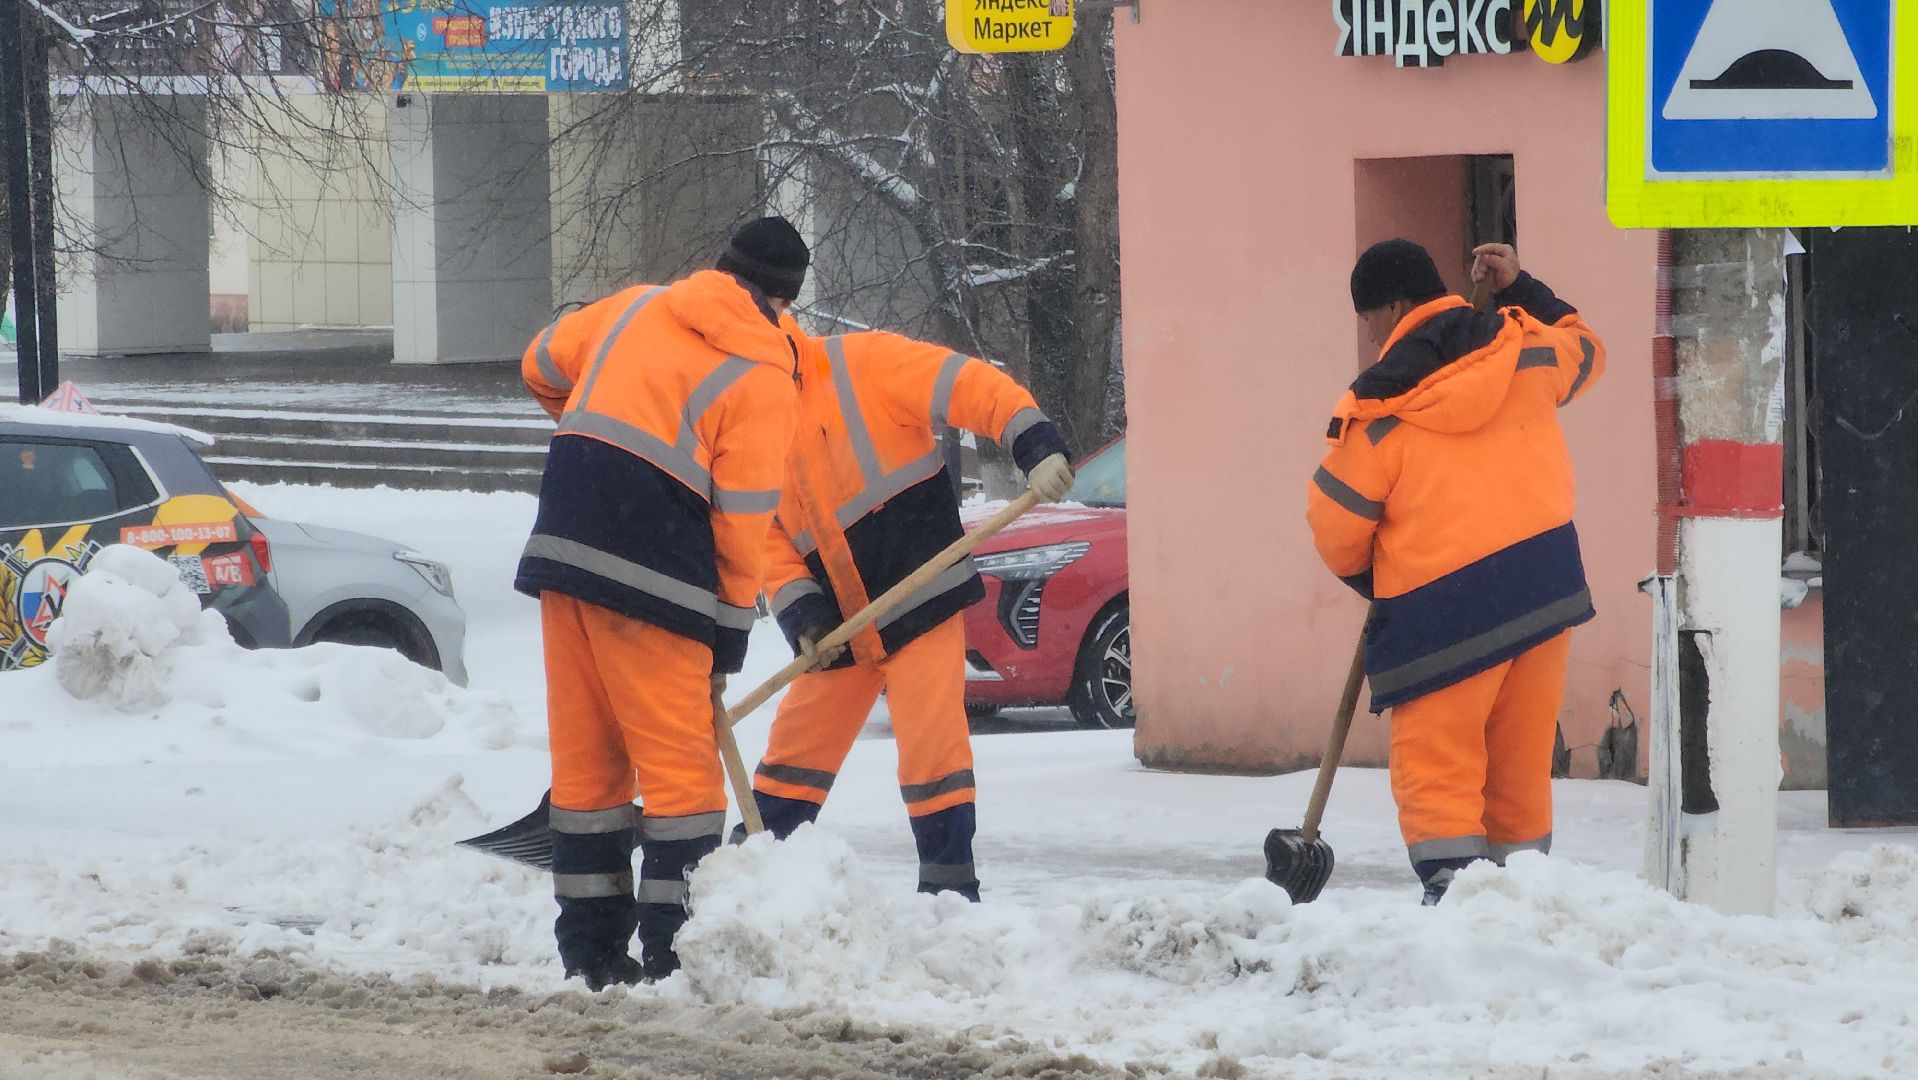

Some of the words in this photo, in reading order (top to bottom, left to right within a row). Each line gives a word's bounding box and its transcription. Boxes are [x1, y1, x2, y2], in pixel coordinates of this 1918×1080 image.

[974, 16, 1053, 43] Маркет
[1332, 0, 1511, 68] Яндекс
[550, 46, 623, 87] ГОРОДА
